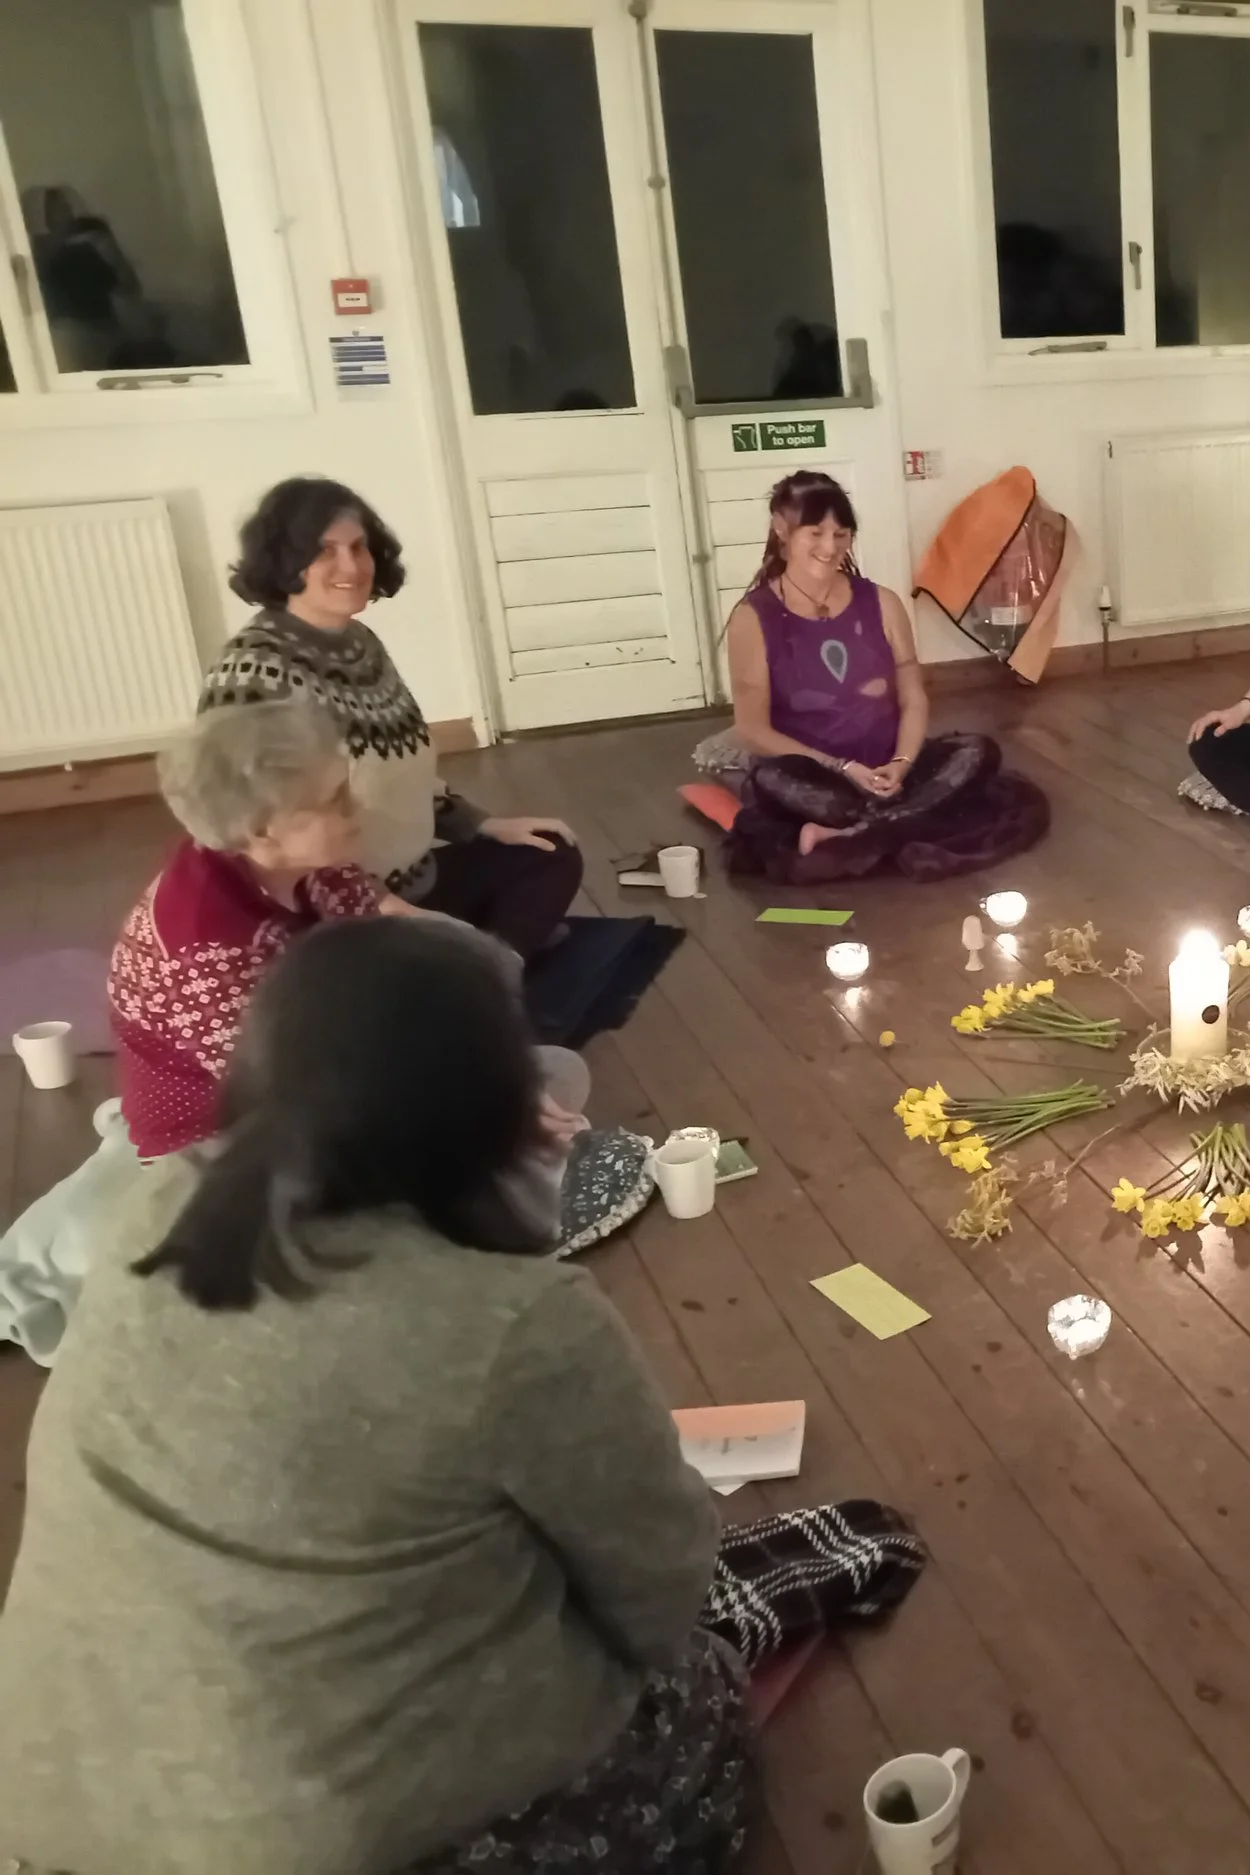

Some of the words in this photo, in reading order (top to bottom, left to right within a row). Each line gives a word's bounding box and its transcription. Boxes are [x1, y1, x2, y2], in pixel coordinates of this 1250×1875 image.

[767, 424, 796, 435] Push
[798, 423, 816, 433] bar
[772, 436, 785, 446] to
[787, 436, 815, 447] open
